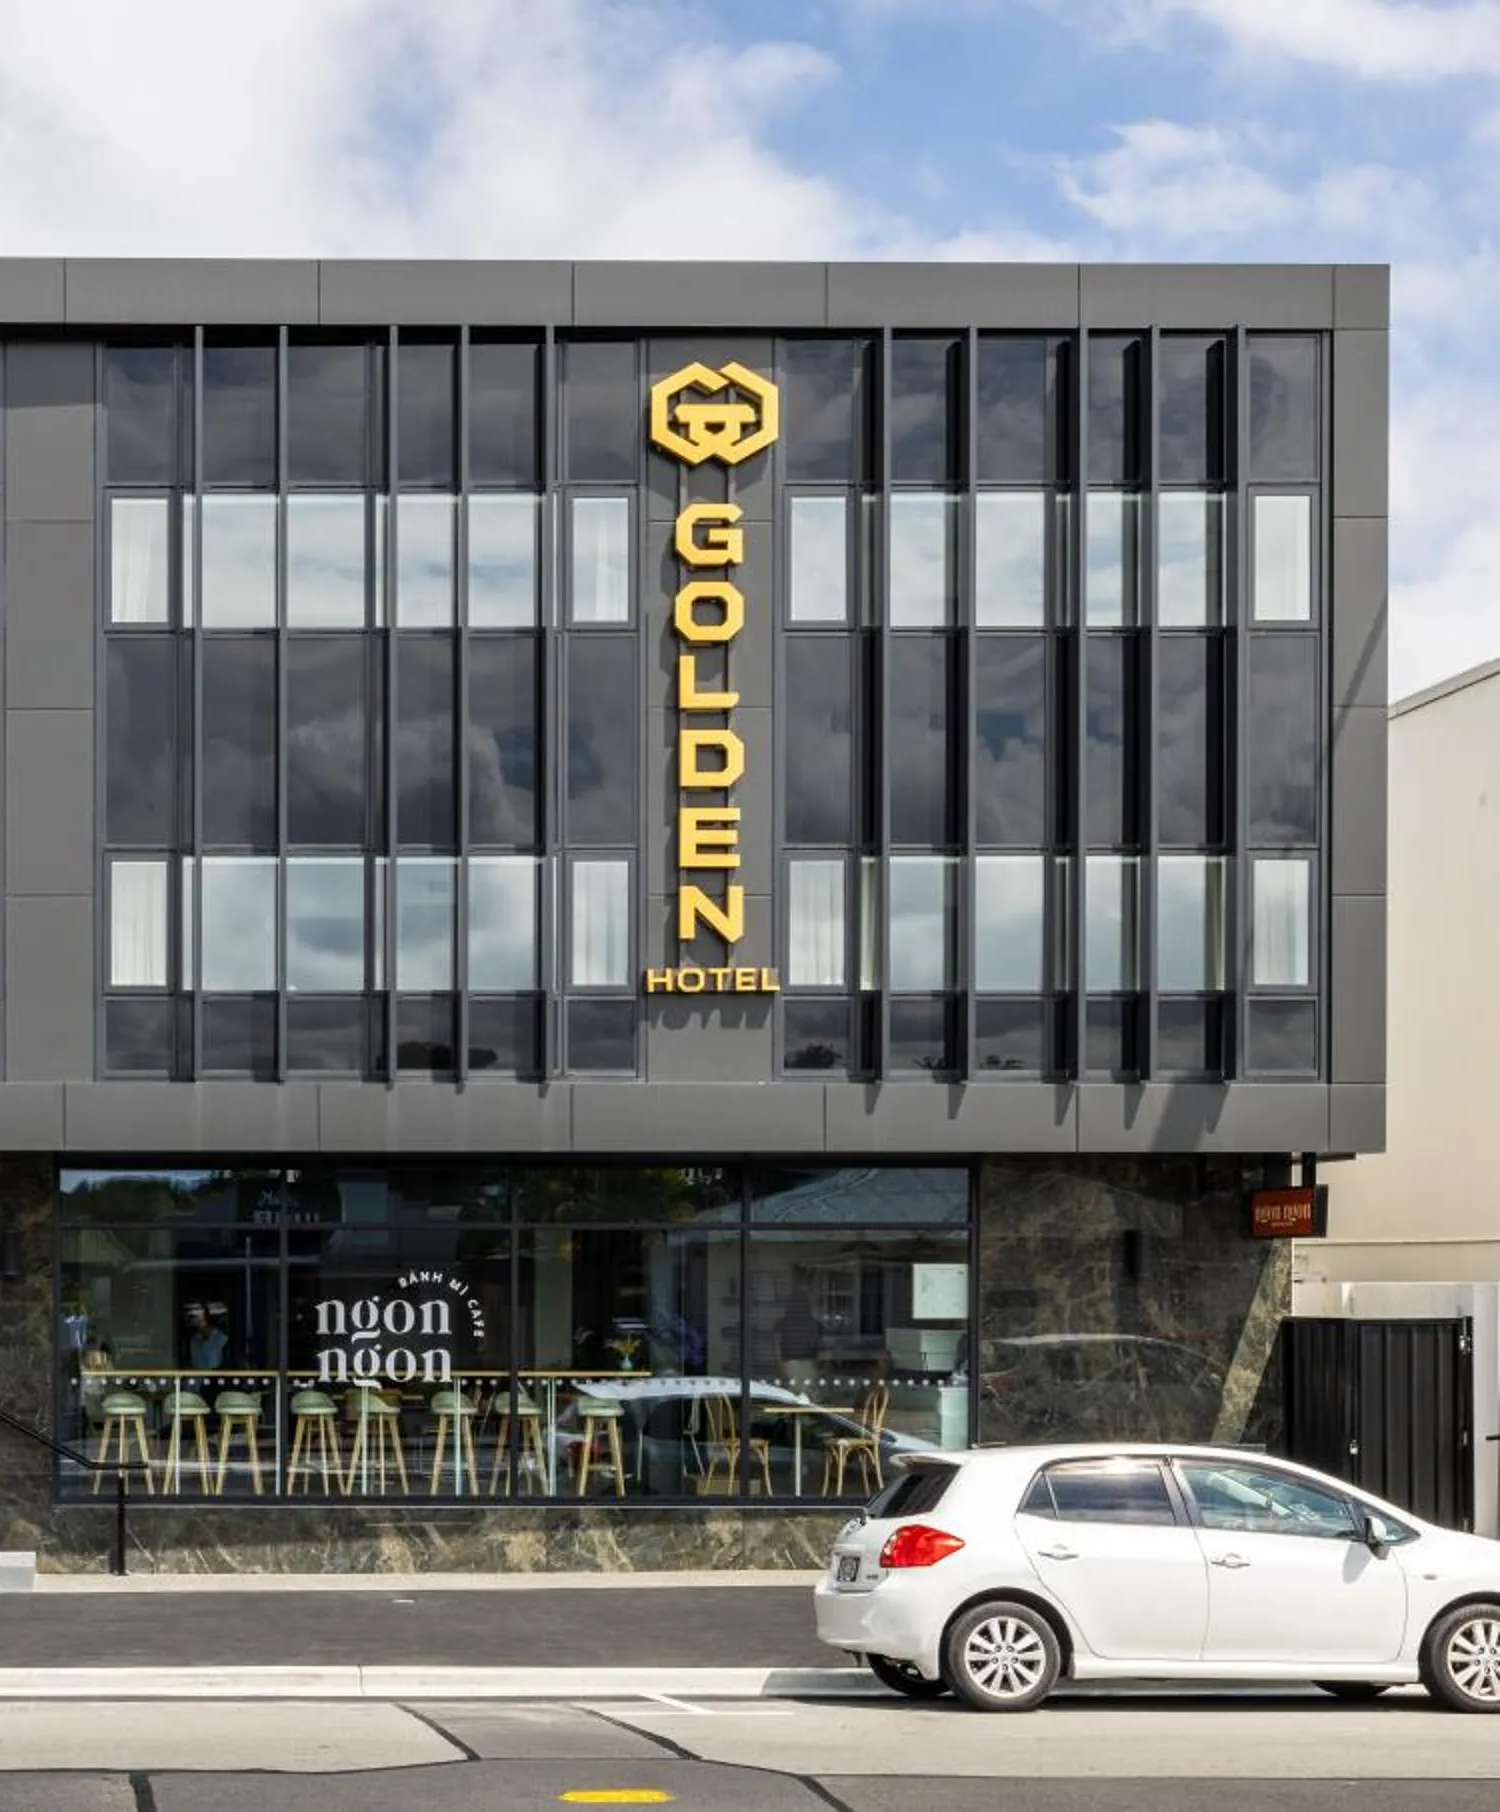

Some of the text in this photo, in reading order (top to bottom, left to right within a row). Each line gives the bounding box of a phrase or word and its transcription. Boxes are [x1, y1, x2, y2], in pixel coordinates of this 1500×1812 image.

[675, 504, 744, 943] GOLDEN
[646, 967, 781, 993] HOTEL
[314, 1295, 452, 1344] ngon
[316, 1344, 453, 1391] ngon
